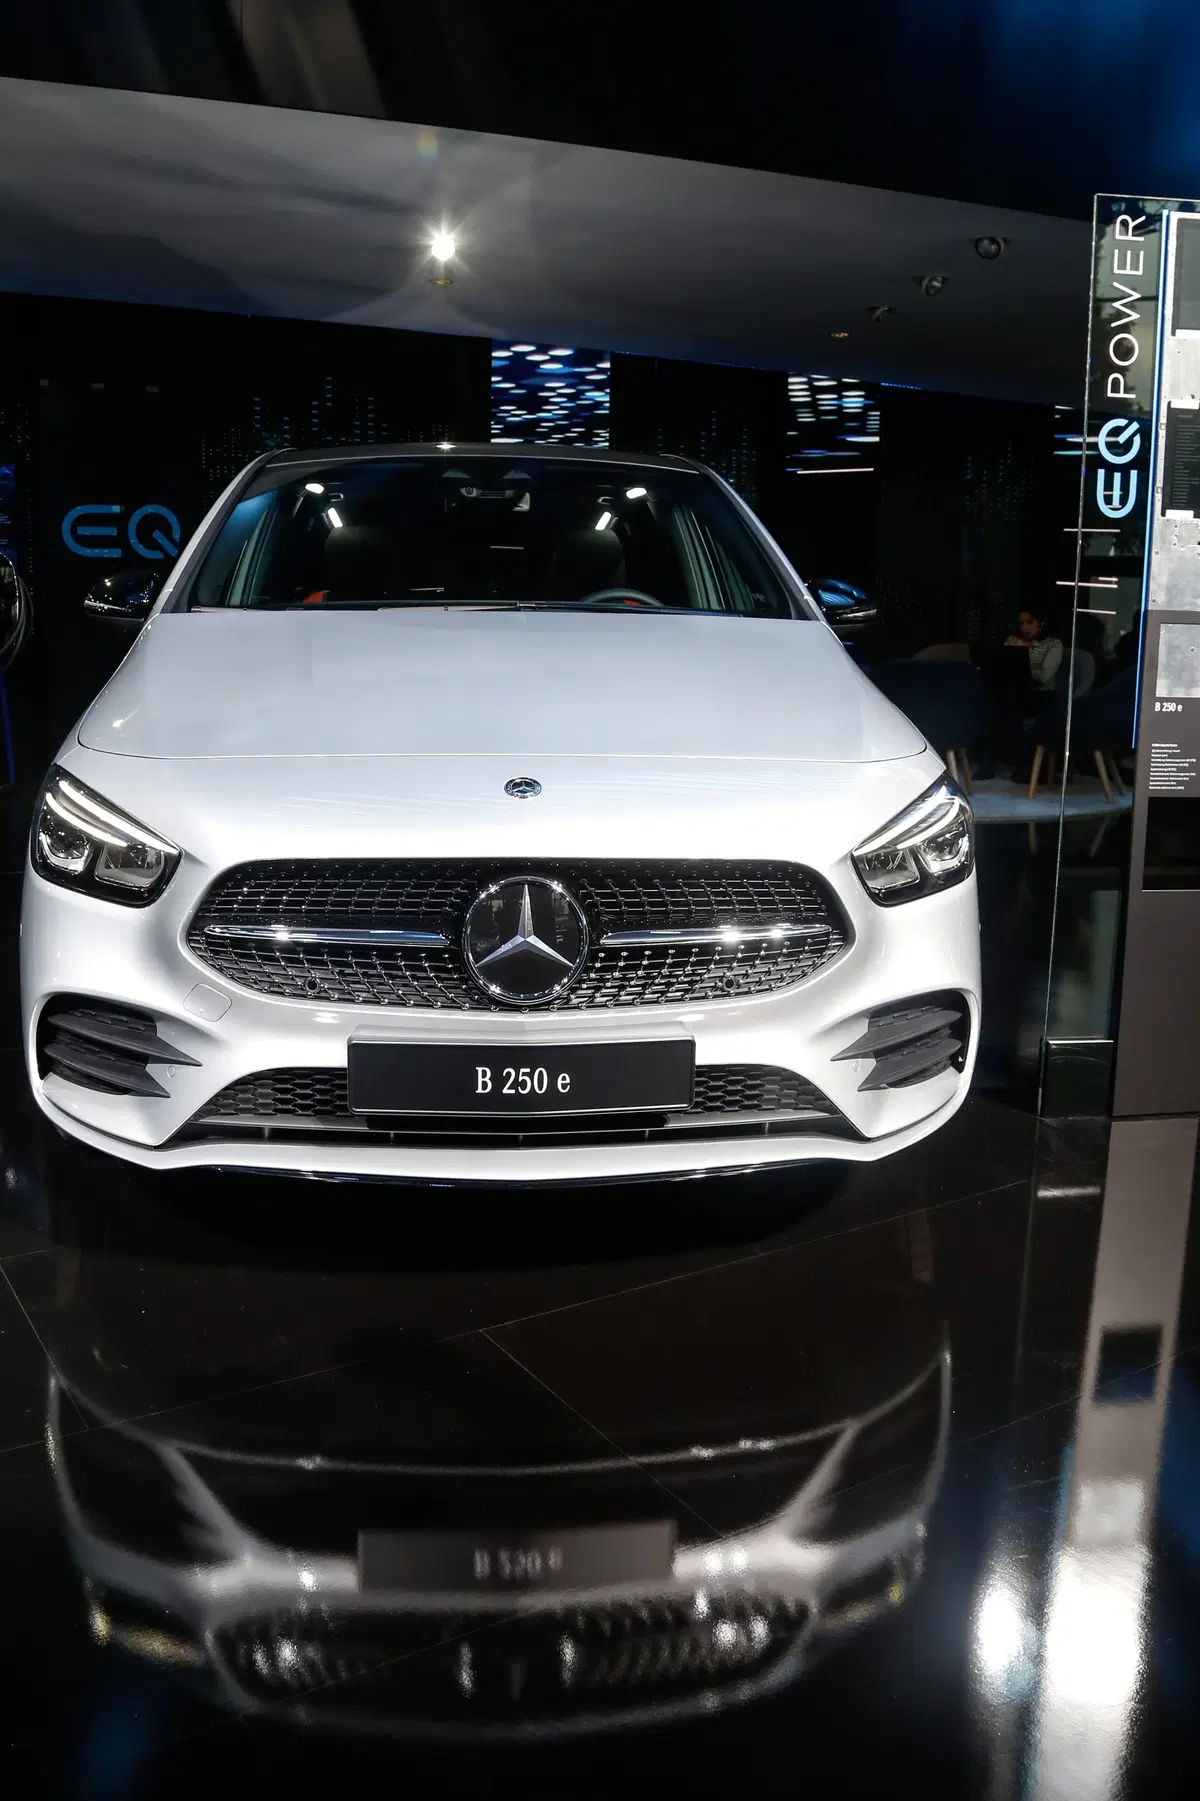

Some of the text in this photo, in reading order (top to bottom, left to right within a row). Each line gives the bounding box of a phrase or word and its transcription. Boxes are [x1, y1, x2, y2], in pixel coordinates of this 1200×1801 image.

[1096, 214, 1147, 519] EQ POWER
[62, 504, 181, 559] EQ
[1154, 701, 1183, 712] B 250 e
[475, 1066, 571, 1094] B 250 e
